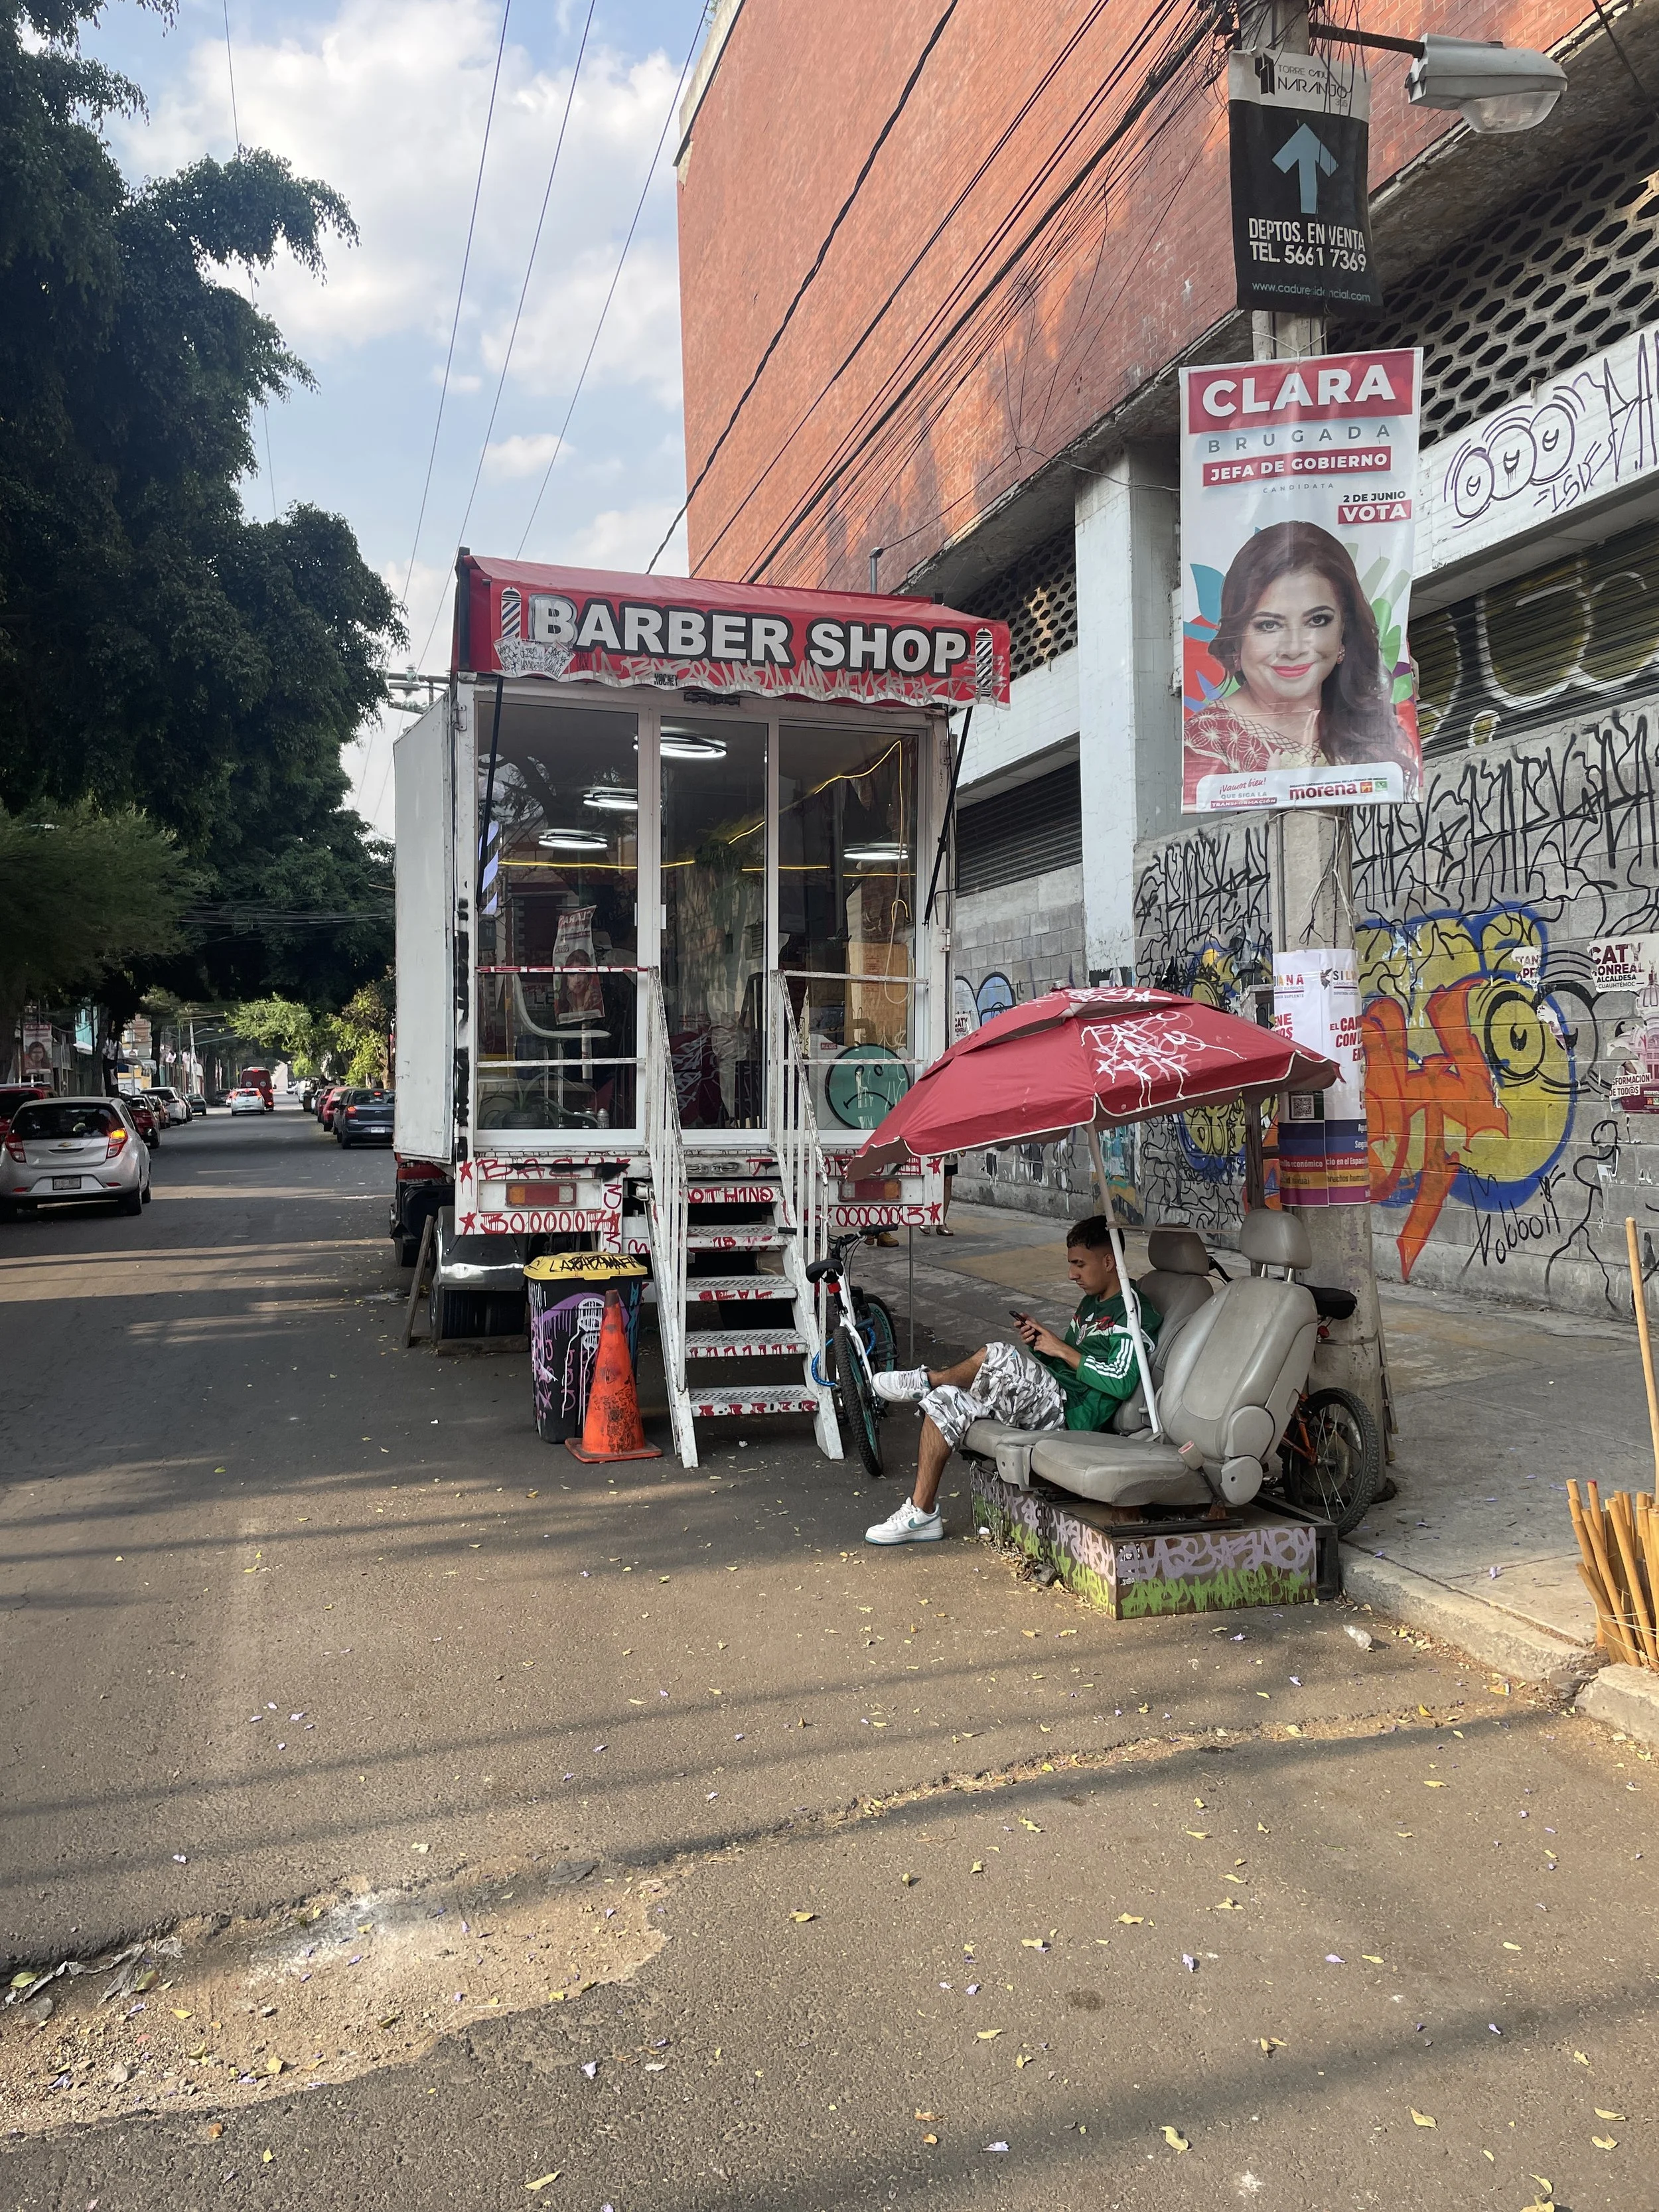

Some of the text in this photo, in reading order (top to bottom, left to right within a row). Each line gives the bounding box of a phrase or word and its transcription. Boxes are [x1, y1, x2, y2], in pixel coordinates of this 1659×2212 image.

[1277, 64, 1305, 76] TORRE
[1277, 76, 1348, 99] NARANJO
[1248, 217, 1366, 252] DEPTOS. EN VENTA
[1249, 241, 1367, 272] TEL. 5661 7369
[1202, 364, 1396, 417] CLARA
[1208, 423, 1390, 453] BRUGADA
[1210, 453, 1388, 482] JEFA DE GOBIERNO
[1263, 482, 1334, 494] CANDIDATA
[1342, 490, 1406, 503] 2 DE JUNIO
[1342, 503, 1407, 522] VOTA
[533, 597, 791, 664] BARBER
[809, 622, 968, 673] SHOP
[1289, 782, 1358, 800] morena
[1212, 798, 1276, 807] TRANSFORMACIÓN
[1597, 974, 1637, 983] ALCALDESA
[1336, 1033, 1355, 1048] CON
[1617, 1086, 1639, 1096] TOD@S
